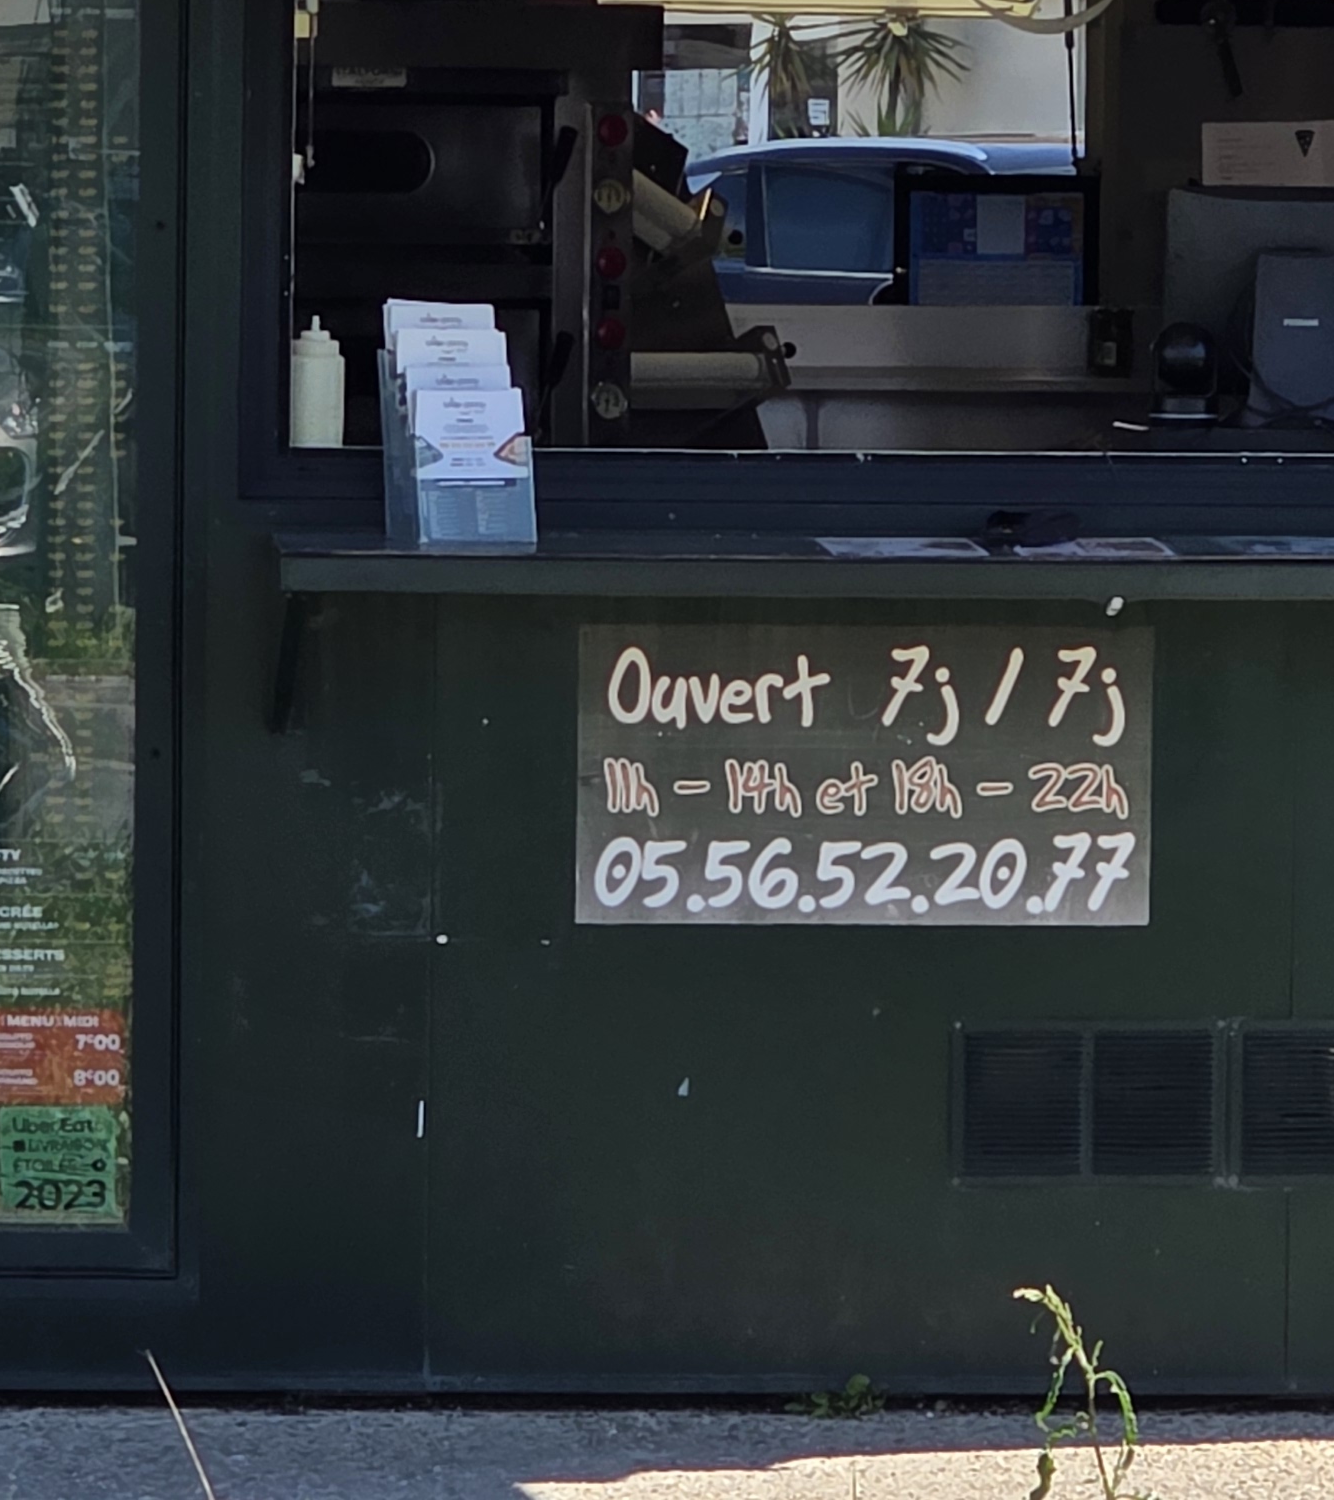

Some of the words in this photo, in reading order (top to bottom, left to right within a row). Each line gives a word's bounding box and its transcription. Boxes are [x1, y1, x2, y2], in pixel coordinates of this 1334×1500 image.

[608, 647, 831, 729] Ouvert
[882, 646, 960, 746] 7j
[985, 647, 1023, 725] /
[1048, 646, 1126, 746] 7j
[604, 758, 658, 817] 11h
[673, 778, 710, 795] -
[725, 758, 802, 817] 14h
[816, 760, 878, 816] et
[892, 756, 962, 818] 18h
[977, 781, 1013, 795] -
[1028, 762, 1128, 819] 22h
[594, 832, 1135, 913] 05.56.52.20.77
[7, 1014, 54, 1027] MENU
[13, 1179, 106, 1211] 2023
